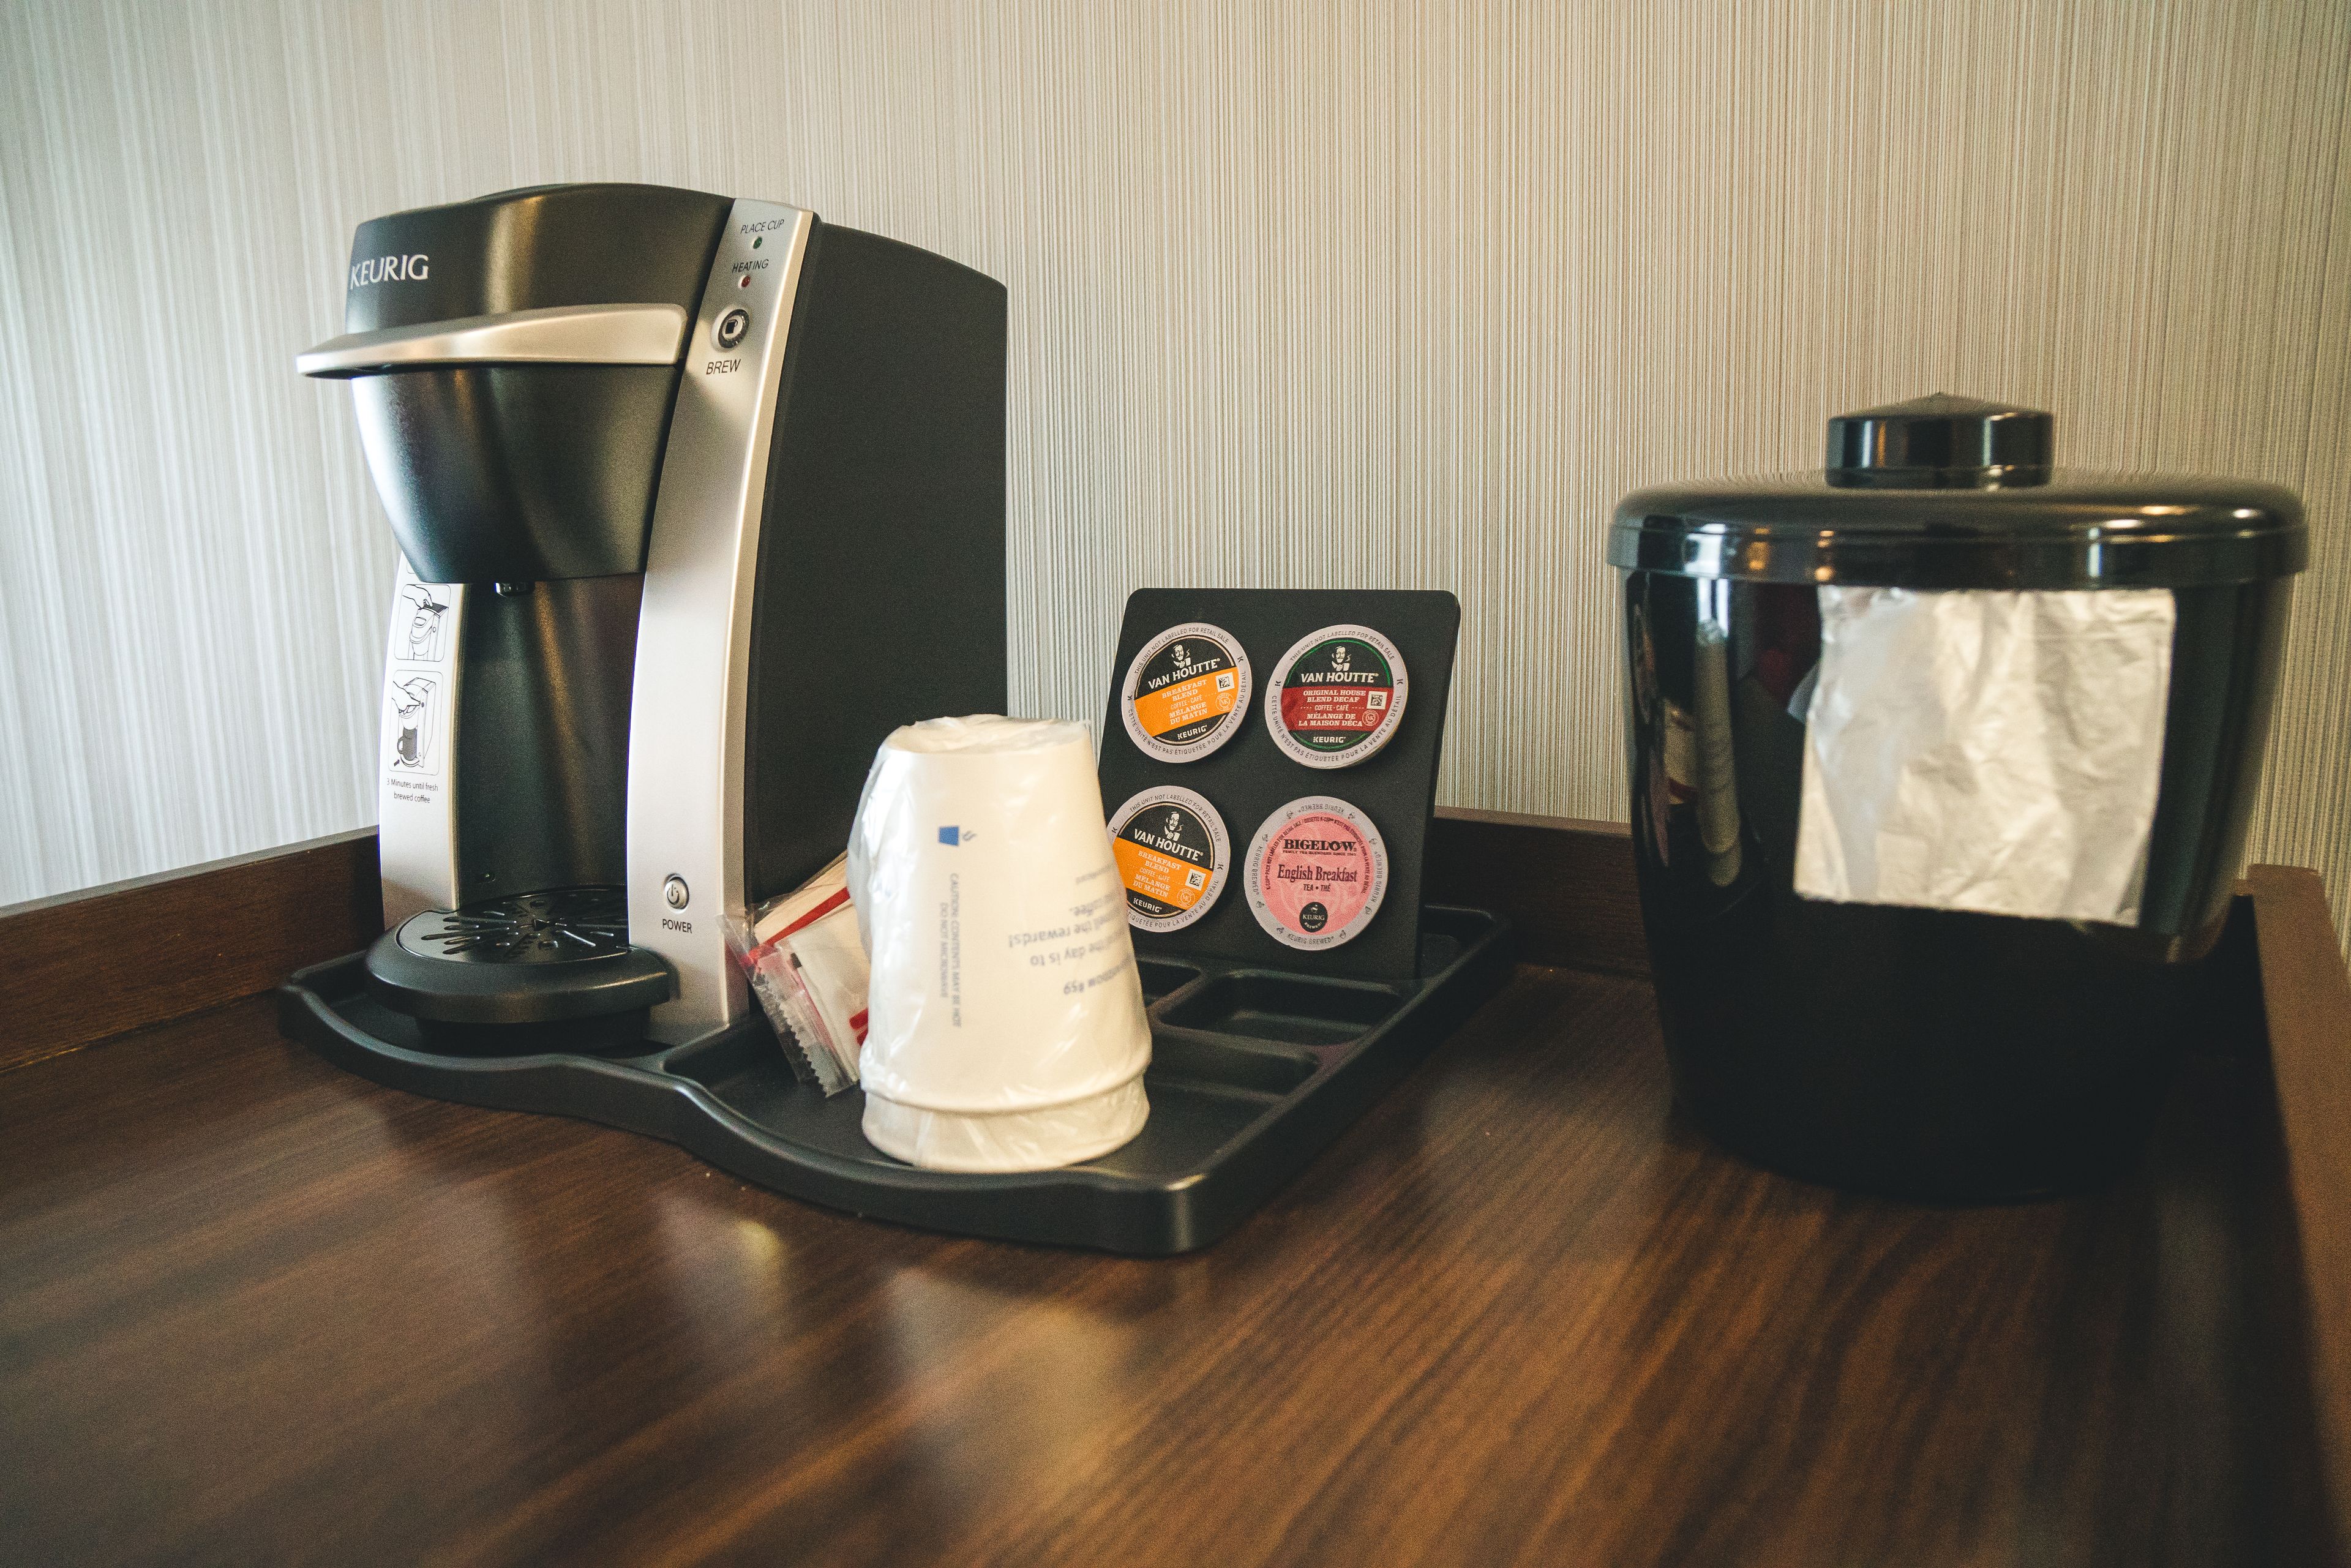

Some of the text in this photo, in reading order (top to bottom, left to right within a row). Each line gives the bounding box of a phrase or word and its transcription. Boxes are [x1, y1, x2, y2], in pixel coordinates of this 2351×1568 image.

[740, 219, 784, 234] PLACE CUP
[350, 253, 429, 290] KEURIG
[732, 258, 769, 273] HEATING
[706, 359, 741, 375] BREW
[1134, 661, 1143, 674] THIS
[1142, 650, 1152, 662] UNIT
[1151, 640, 1161, 650] NOT
[1162, 628, 1188, 643] LABELLED
[1200, 627, 1216, 637] RETAIL
[1217, 634, 1229, 644] SALE
[1290, 650, 1301, 661] THIS
[1301, 640, 1314, 651] UNIT
[1314, 635, 1325, 644] NOT
[1368, 636, 1384, 650] RETAIL
[1383, 648, 1395, 661] SALE
[1148, 674, 1170, 689] VAN
[1301, 673, 1323, 683] VAN
[1161, 679, 1207, 699] BREAKFAST
[1172, 689, 1198, 701] BLEND
[1182, 708, 1208, 721] MATIN
[1208, 732, 1223, 745] POUR
[1223, 724, 1230, 733] LA
[1228, 705, 1242, 725] VENTE
[1239, 694, 1245, 704] AU
[1273, 716, 1283, 734] UNITÉ
[1293, 746, 1304, 756] PAS
[1341, 750, 1359, 760] POUR
[1368, 728, 1386, 746] VENTE
[1385, 718, 1393, 727] AU
[391, 779, 411, 789] Minutes
[426, 782, 438, 791] fresh
[394, 790, 430, 803] brewed coffee
[1129, 803, 1141, 812] THIS
[1166, 794, 1193, 805] LABELLED
[1193, 802, 1203, 813] FOR
[1202, 811, 1215, 826] RETAIL
[1212, 827, 1221, 842] SALE
[1134, 828, 1156, 845] VAN
[1138, 850, 1182, 870] BREAKFAST
[1145, 860, 1169, 873] BLEND
[1277, 864, 1357, 883] English Breakfast
[1133, 880, 1169, 898] DU MATIN
[1181, 909, 1198, 923] VENTE
[662, 918, 692, 934] POWER
[1008, 926, 1070, 948] rewards!
[1030, 954, 1046, 966] to
[1049, 953, 1061, 965] is
